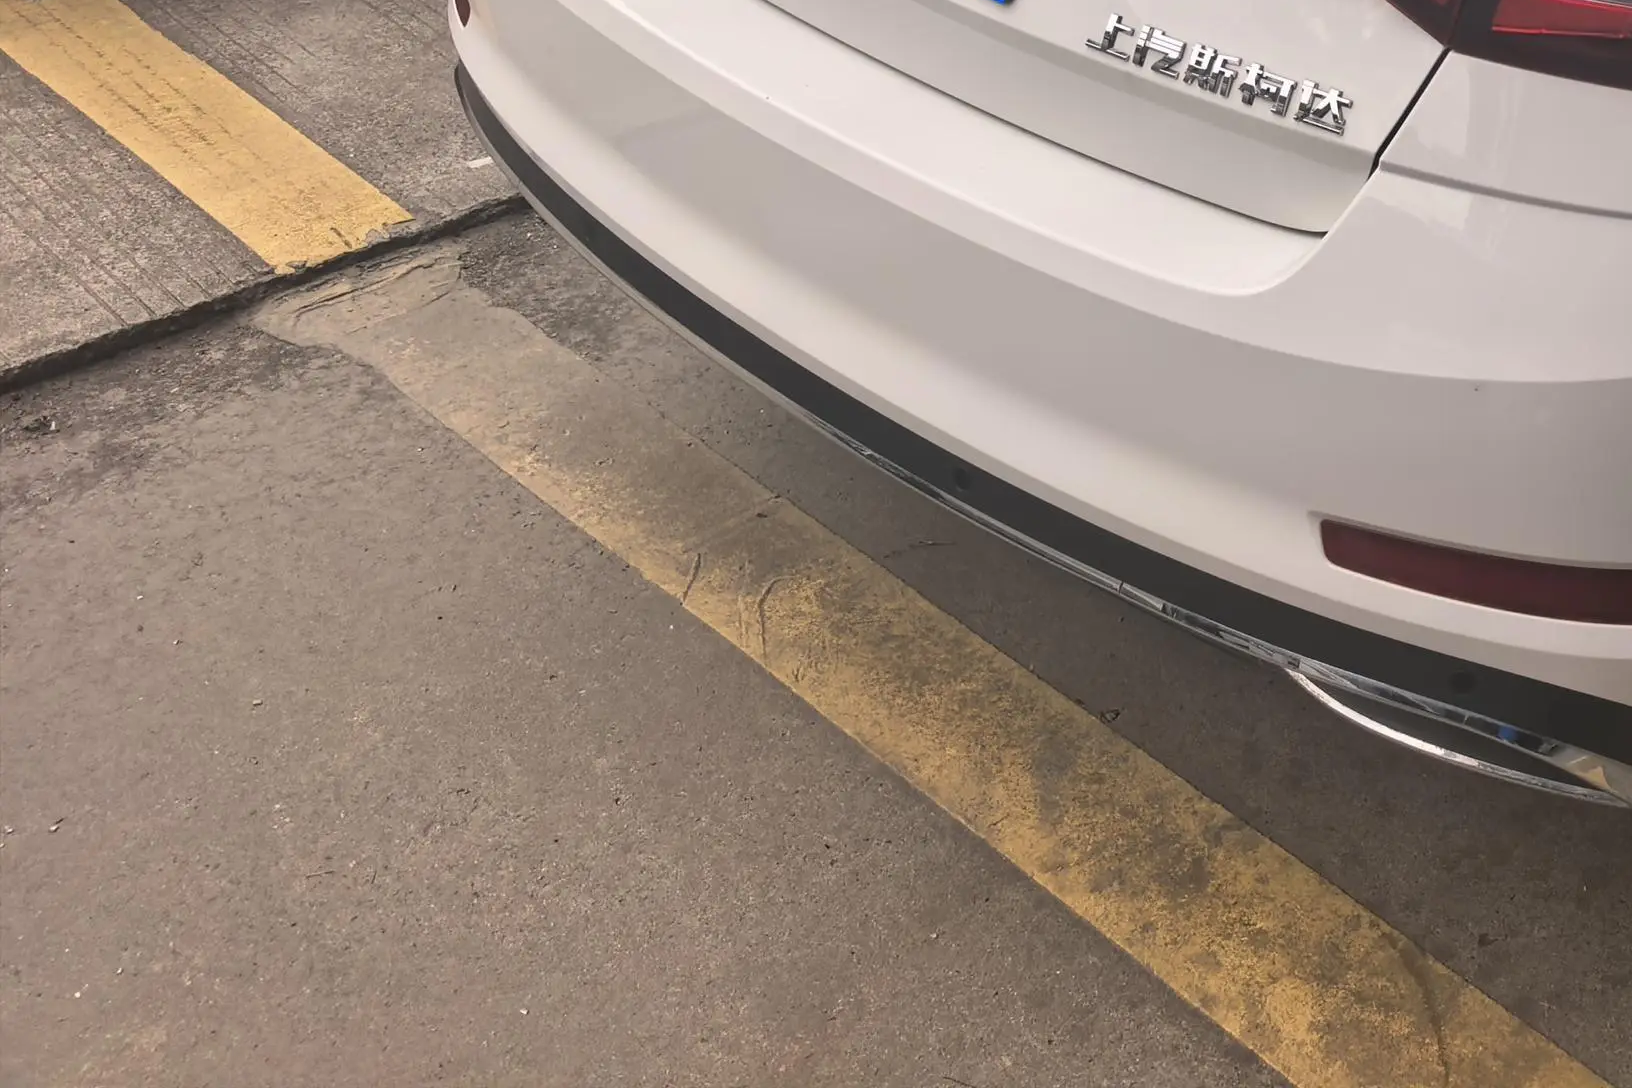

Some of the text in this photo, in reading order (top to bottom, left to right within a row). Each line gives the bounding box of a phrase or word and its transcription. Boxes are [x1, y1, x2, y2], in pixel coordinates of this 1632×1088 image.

[1085, 12, 1353, 136] 上汽斯柯达
